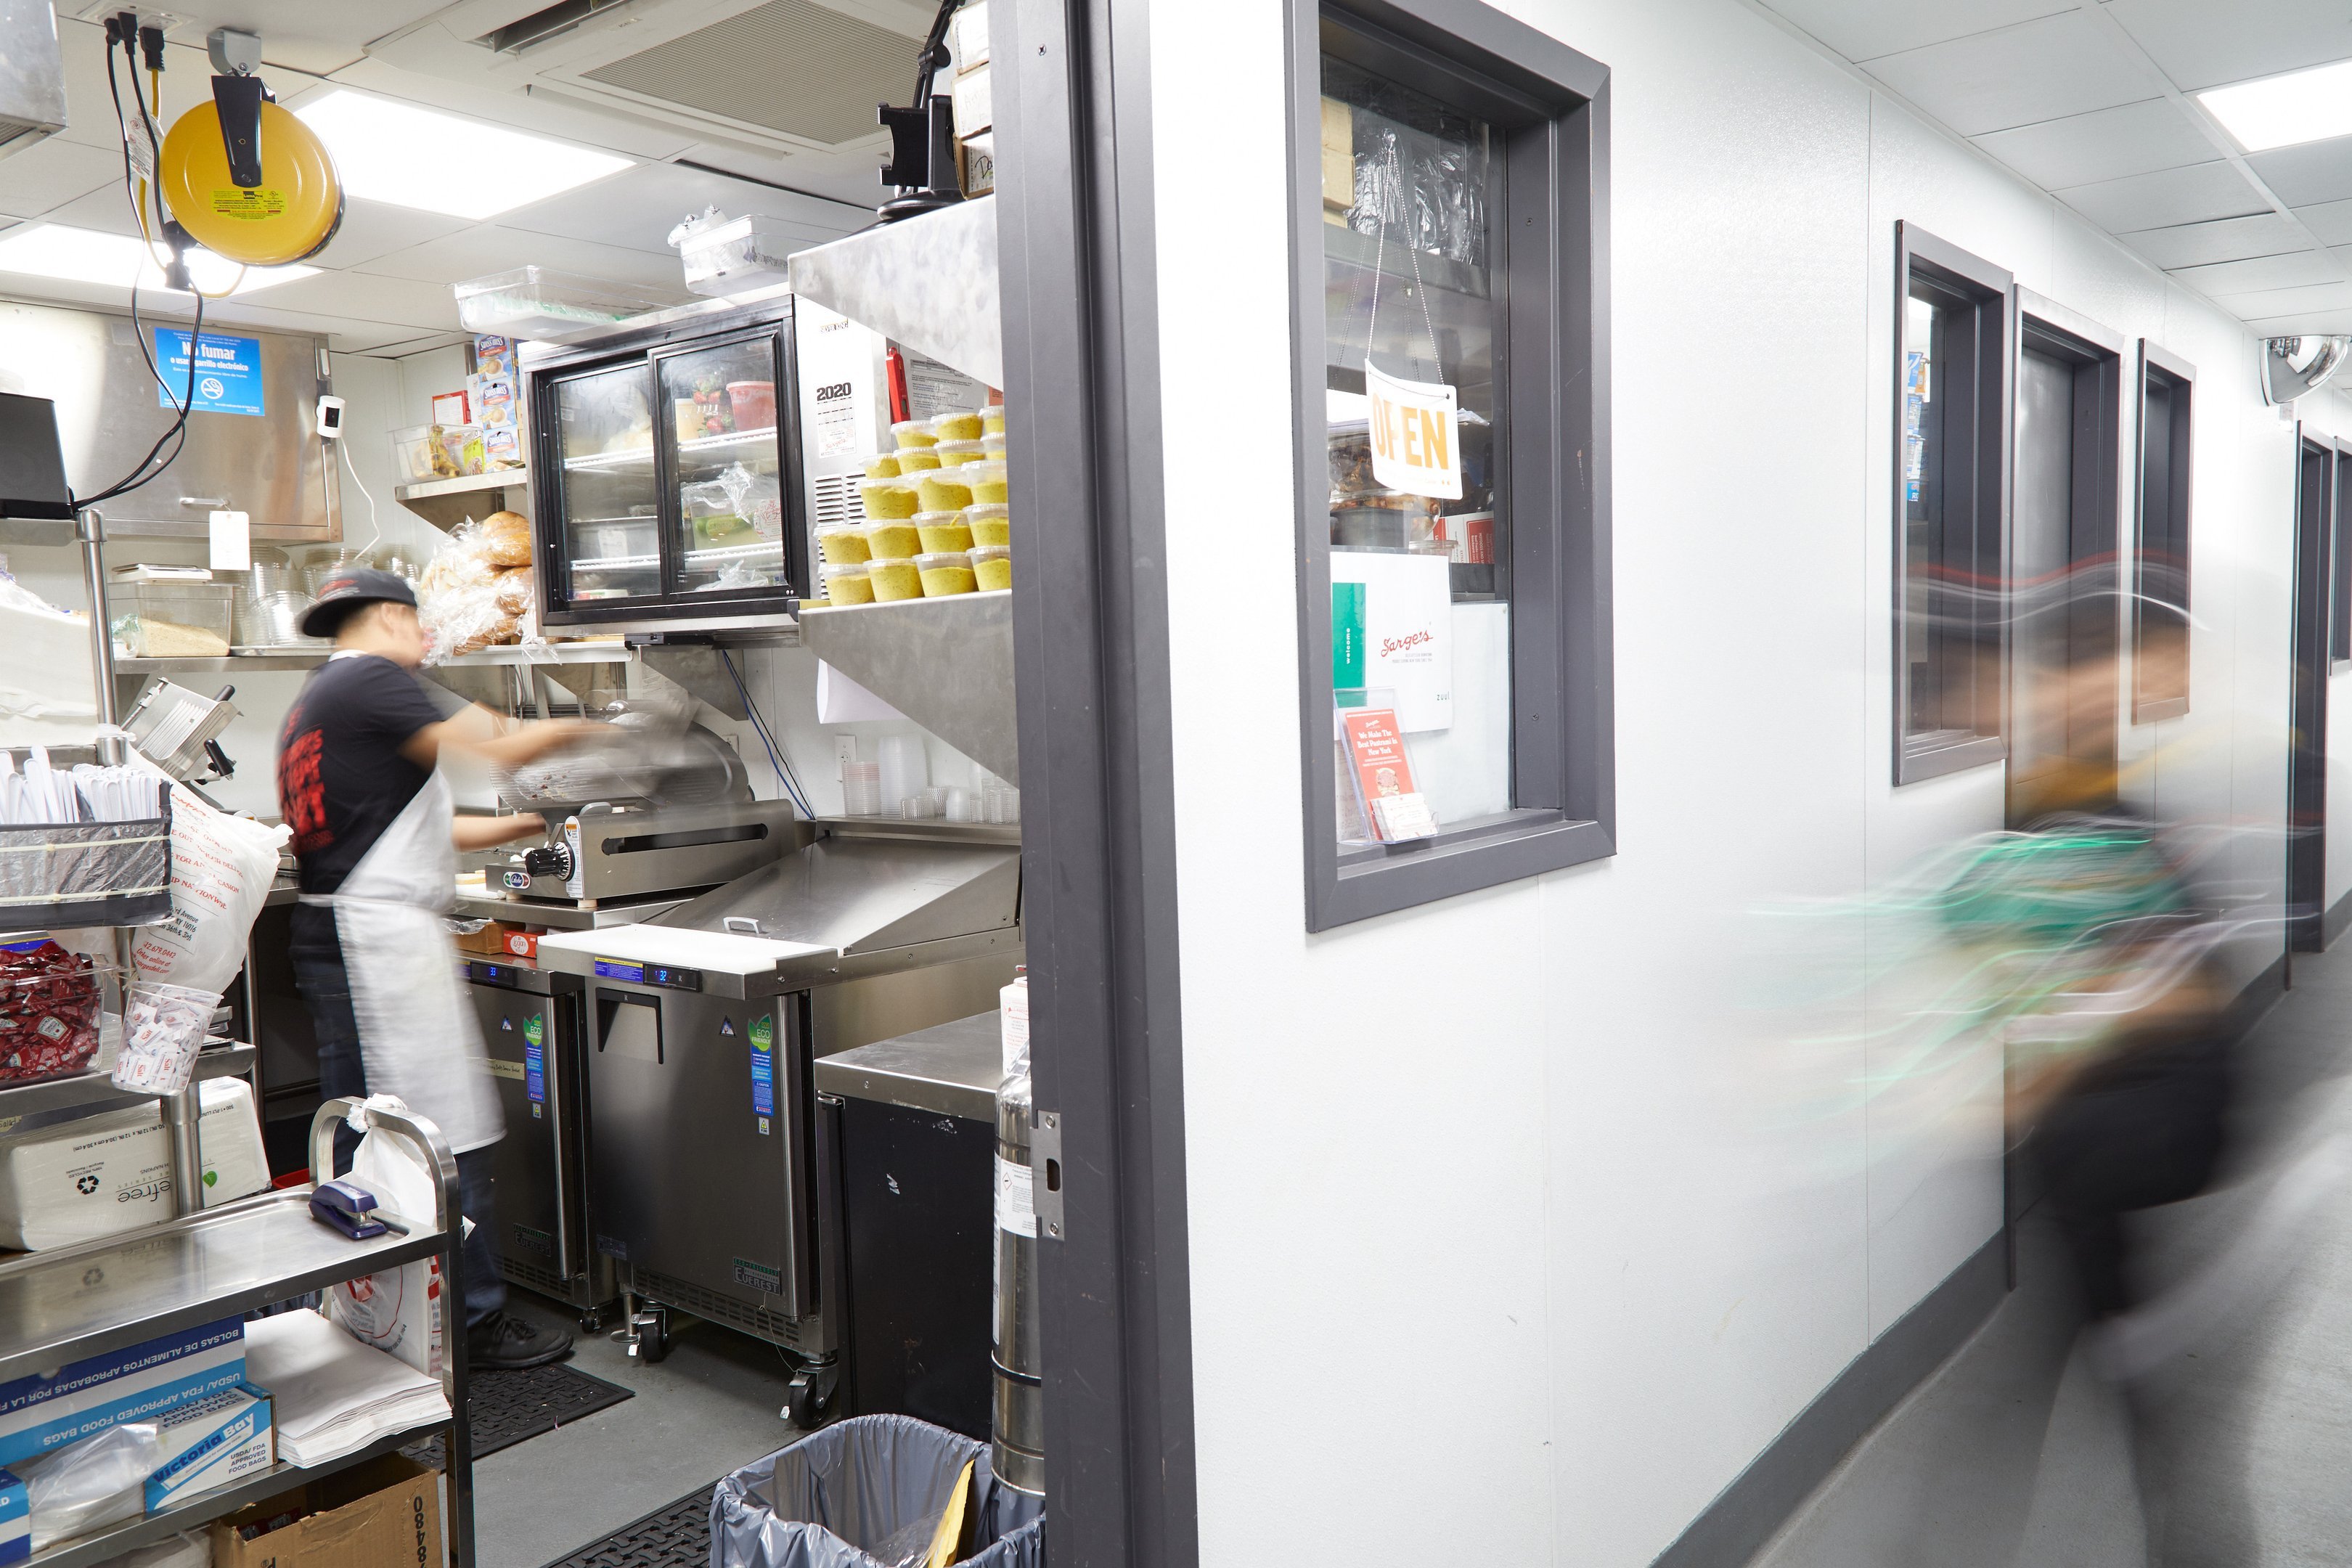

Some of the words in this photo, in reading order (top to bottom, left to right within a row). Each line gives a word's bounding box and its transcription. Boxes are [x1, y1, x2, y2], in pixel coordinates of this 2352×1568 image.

[201, 344, 235, 360] fumar
[195, 359, 216, 368] garrillo
[217, 361, 248, 372] electrónico
[817, 382, 852, 401] 2020
[1372, 393, 1449, 470] OPEN
[1381, 630, 1434, 658] Sarge's
[180, 910, 199, 923] Avenue
[150, 957, 164, 965] online
[491, 967, 497, 976] 33
[660, 970, 667, 981] 32
[530, 1026, 542, 1035] ECO
[756, 1029, 769, 1038] ECO
[140, 1164, 163, 1175] NAPKINS
[118, 1180, 171, 1203] efree
[735, 1266, 778, 1293] EVEREST
[201, 1328, 239, 1347] BOLSAS
[184, 1342, 198, 1353] DE
[123, 1347, 181, 1372] ALIMENTOS
[55, 1366, 121, 1394] APROBADAS
[207, 1373, 240, 1394] USDA/
[12, 1393, 25, 1406] LA
[28, 1385, 52, 1401] POR
[181, 1383, 205, 1400] FDA
[117, 1392, 179, 1421] APPROVED
[163, 1393, 238, 1423] APPROVED
[163, 1413, 203, 1429] FOOD
[207, 1397, 245, 1413] BAGS
[81, 1416, 115, 1434] FOOD
[44, 1429, 78, 1446] BAGS
[153, 1434, 222, 1484] Victoria
[223, 1413, 254, 1439] Bay
[230, 1447, 251, 1459] USDA/
[229, 1463, 247, 1474] FOOD
[248, 1456, 266, 1466] BAGS
[231, 1449, 266, 1466] APPROVED
[414, 1495, 428, 1568] 8480
